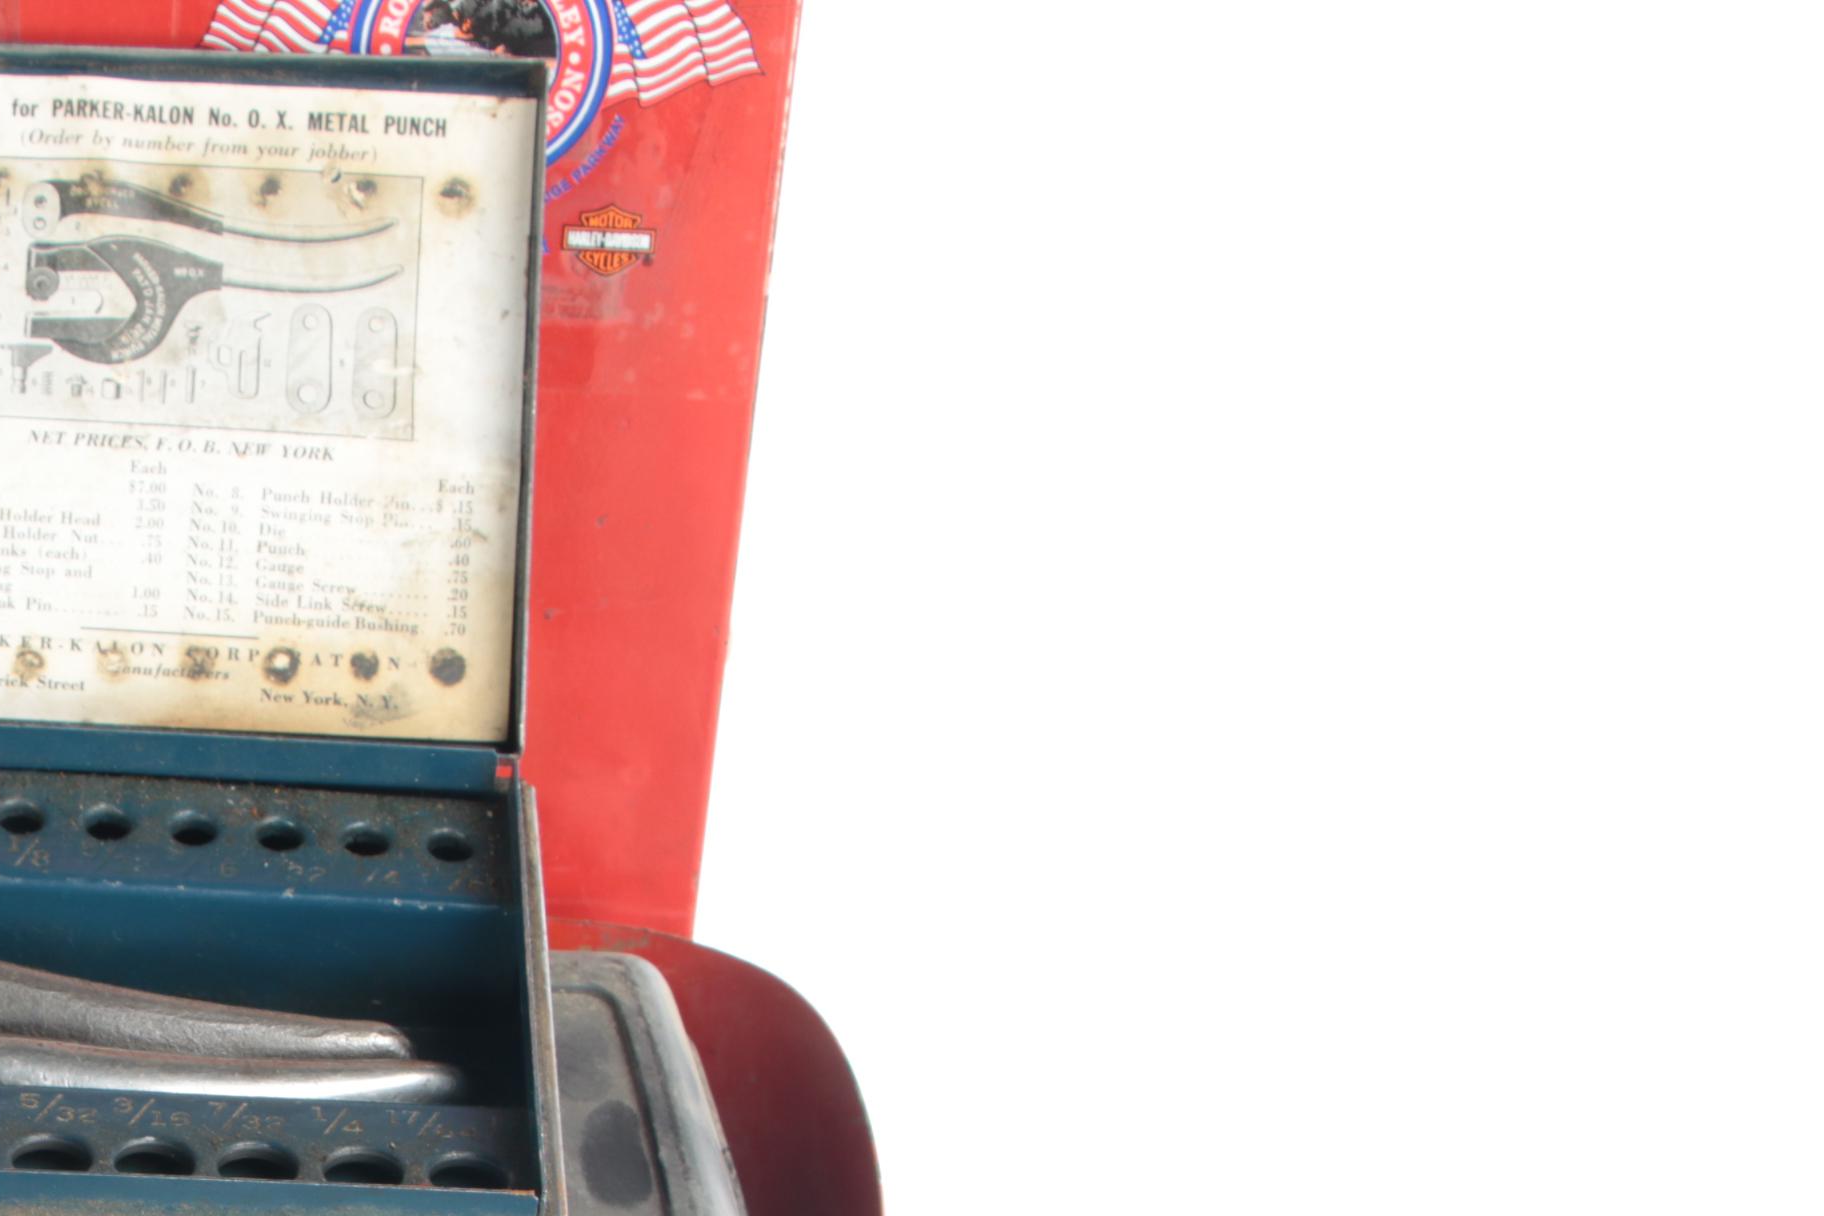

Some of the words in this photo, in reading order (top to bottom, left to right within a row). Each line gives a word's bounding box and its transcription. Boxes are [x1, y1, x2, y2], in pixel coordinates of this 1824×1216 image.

[10, 99, 37, 117] for
[50, 98, 195, 125] PARKER-KALON
[207, 107, 237, 128] No.
[275, 110, 293, 130] X.
[306, 111, 370, 134] METAL
[382, 115, 448, 138] PUNCH
[570, 113, 625, 183] PARKWAY
[589, 211, 633, 229] MOTOR
[584, 250, 631, 271] CYCLES
[436, 478, 476, 495] Each
[35, 675, 86, 691] Street
[20, 1092, 98, 1124] 5/32
[113, 1096, 193, 1129] 3/16
[207, 1100, 286, 1132] 7/32
[311, 1105, 365, 1136] 1/4
